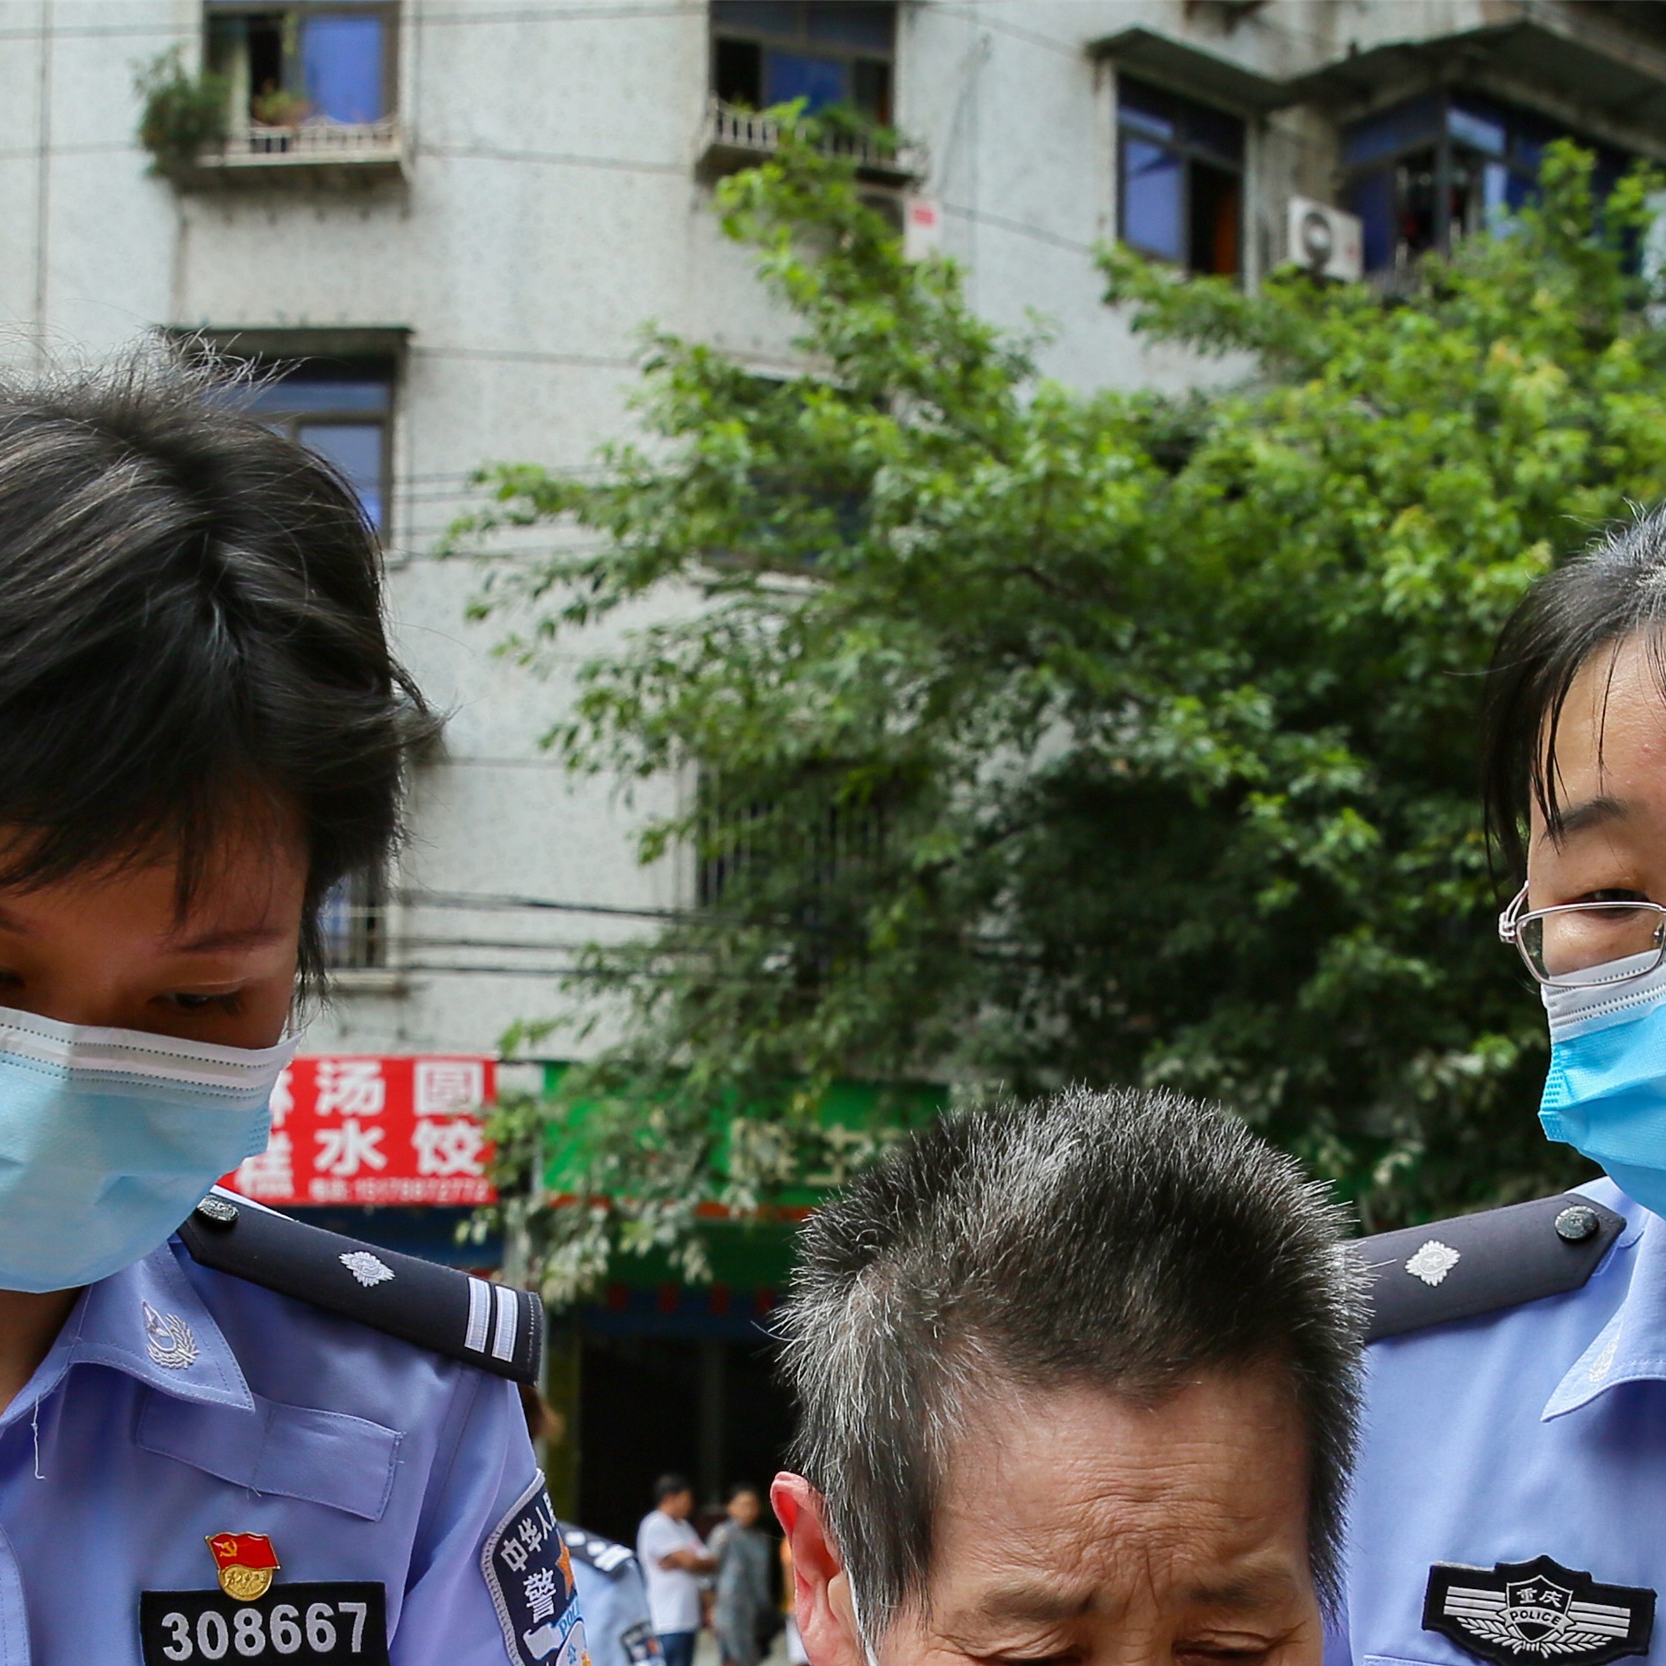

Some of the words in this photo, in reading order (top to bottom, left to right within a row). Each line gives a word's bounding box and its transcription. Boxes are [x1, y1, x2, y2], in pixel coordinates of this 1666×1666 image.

[1516, 1587, 1563, 1608] 重庆
[1510, 1610, 1562, 1625] POLICE
[161, 1601, 368, 1662] 308667
